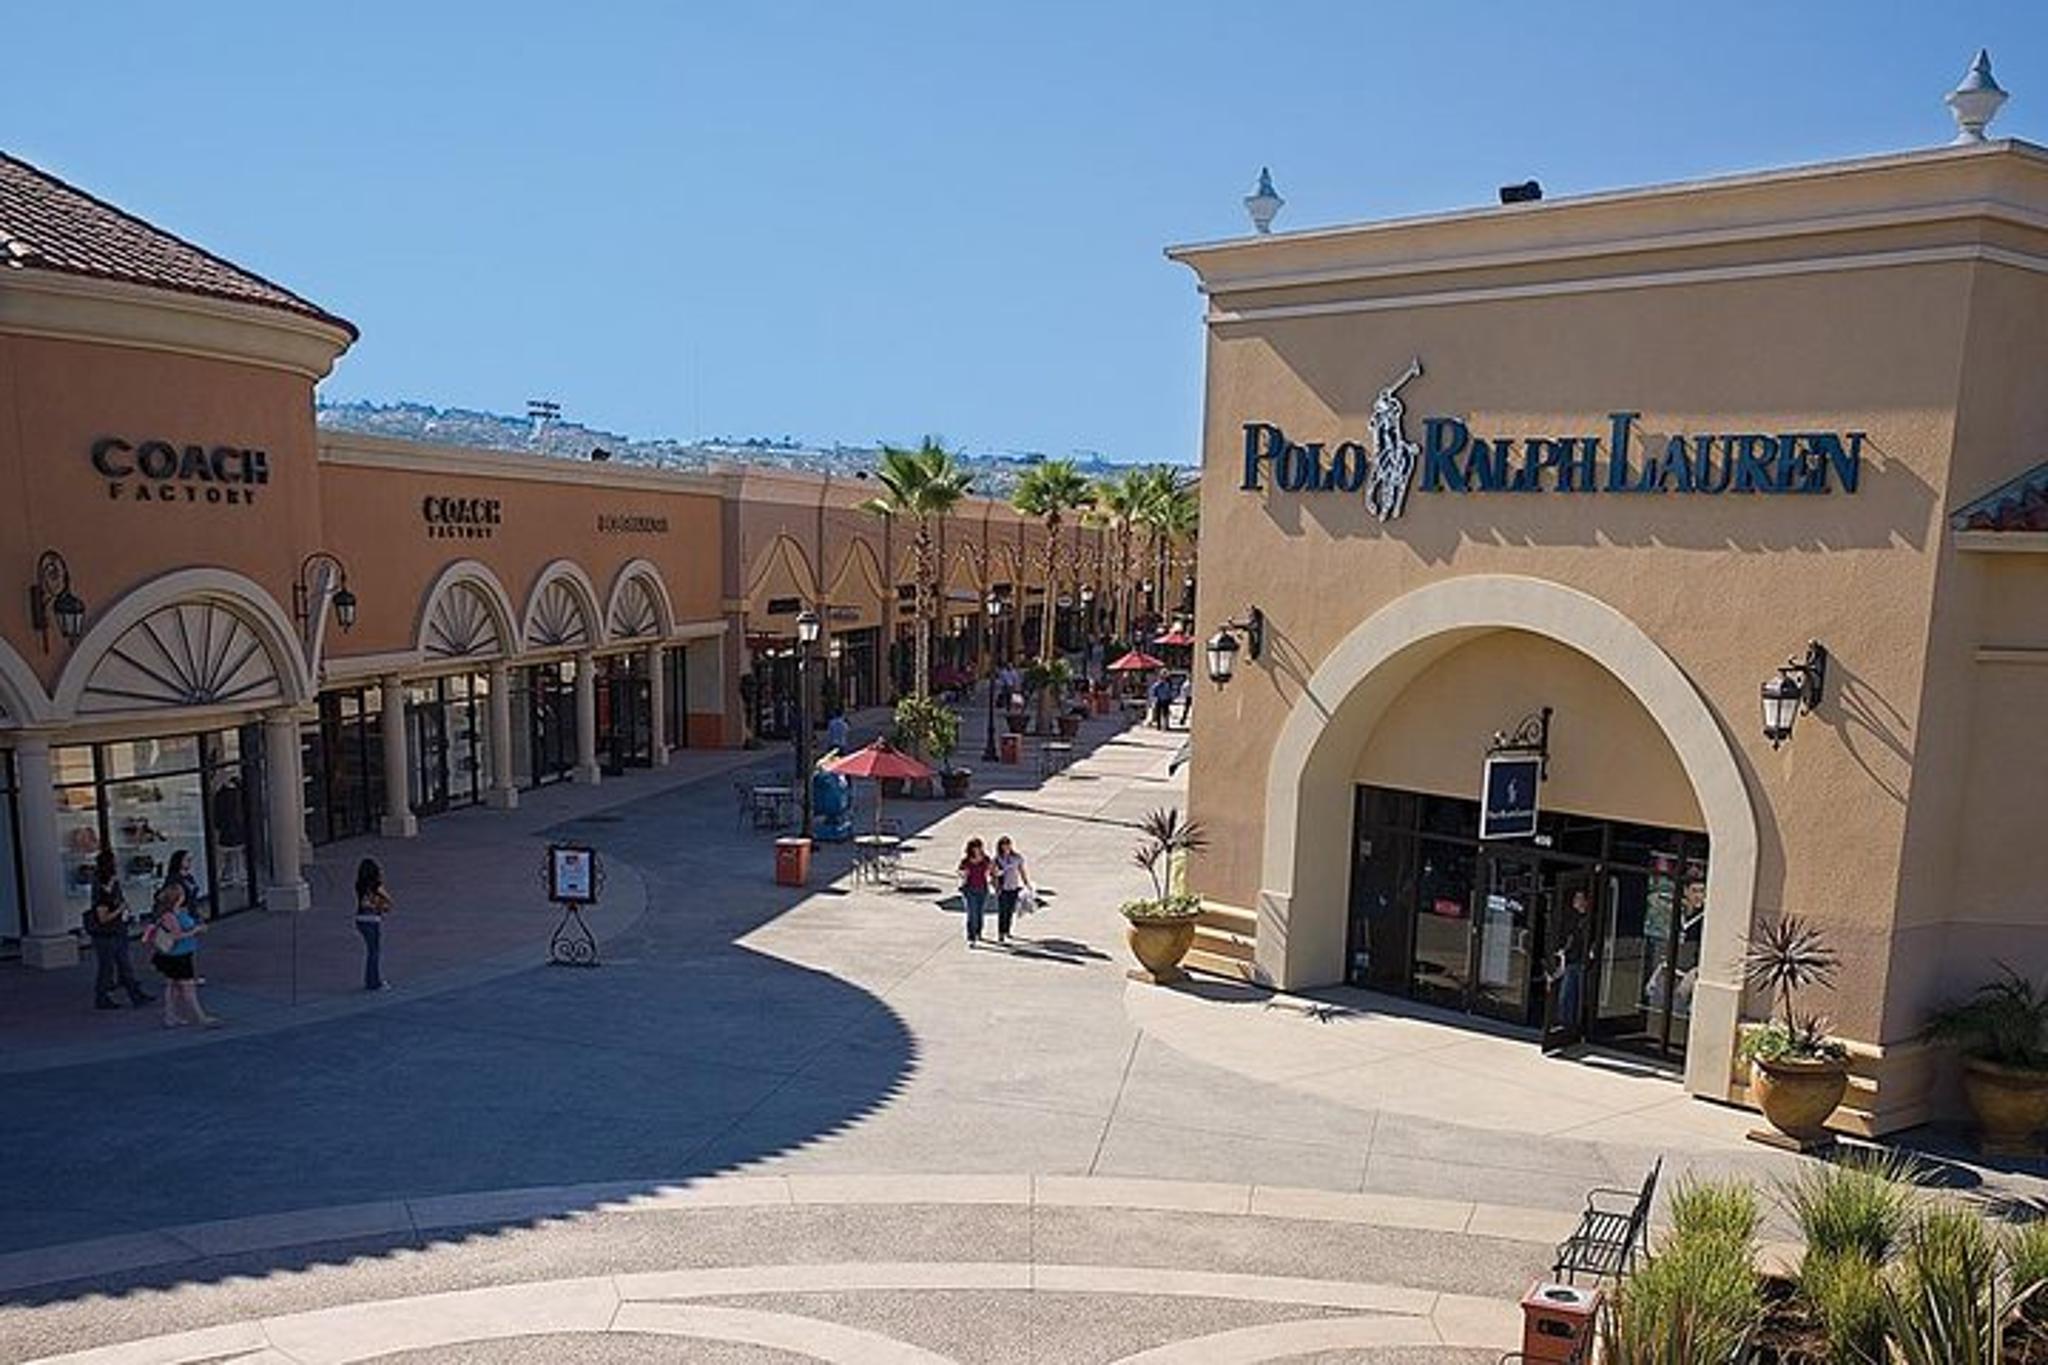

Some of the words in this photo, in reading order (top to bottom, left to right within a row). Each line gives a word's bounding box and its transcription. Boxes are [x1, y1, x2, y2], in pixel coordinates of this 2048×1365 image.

[91, 437, 268, 485] COACH
[109, 484, 255, 504] FACTORY
[423, 496, 501, 524] COACH
